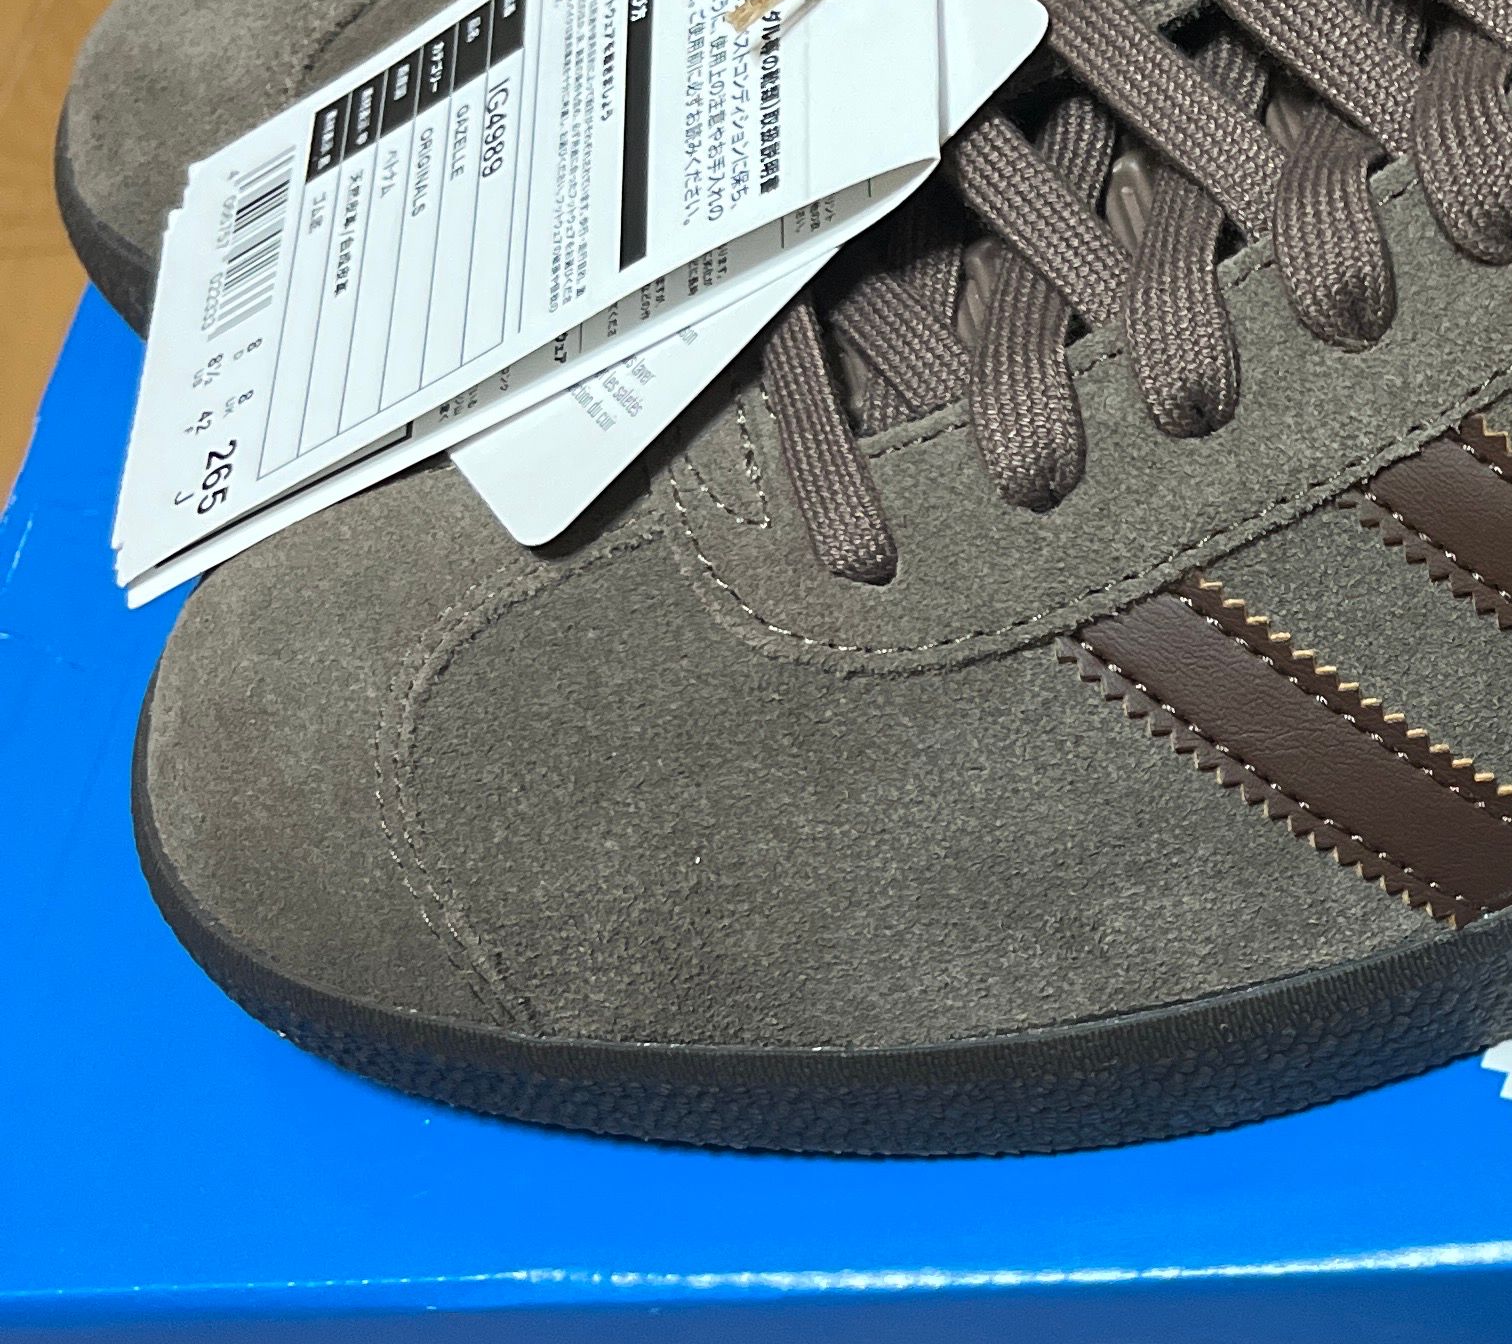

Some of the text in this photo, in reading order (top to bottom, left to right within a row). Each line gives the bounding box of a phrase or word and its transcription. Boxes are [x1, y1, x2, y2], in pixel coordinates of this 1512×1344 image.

[450, 101, 470, 182] GAZELLE
[480, 76, 510, 181] IG4989
[411, 124, 434, 219] ORIGINALS
[236, 335, 263, 407] 8 8
[629, 357, 656, 386] laver
[194, 406, 213, 436] 42
[195, 435, 238, 518] 265
